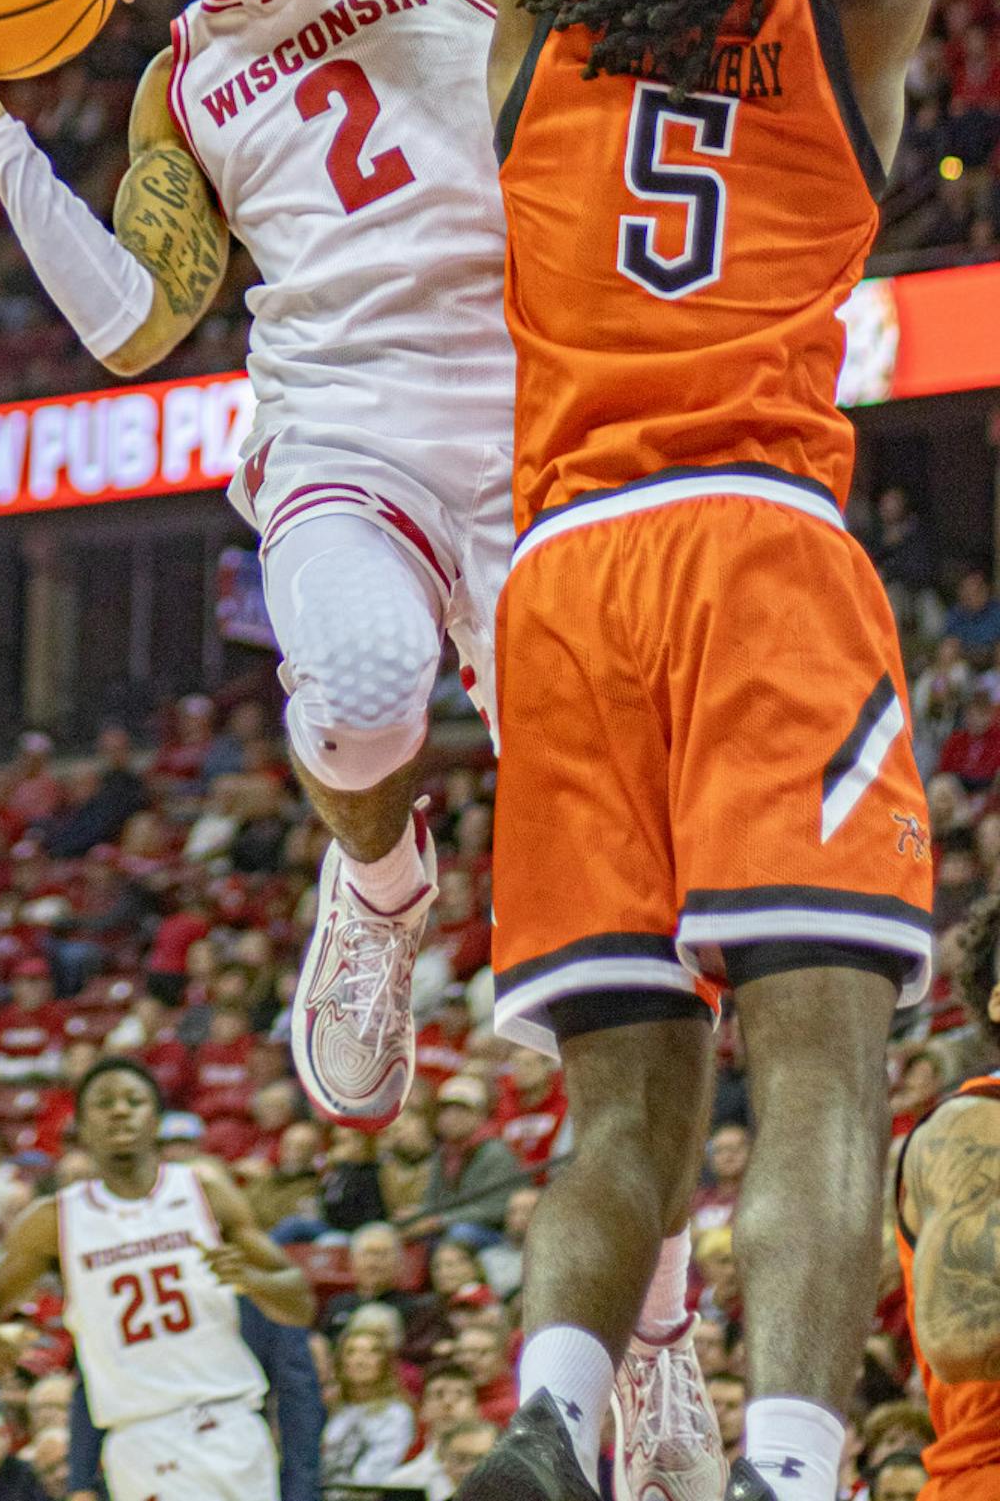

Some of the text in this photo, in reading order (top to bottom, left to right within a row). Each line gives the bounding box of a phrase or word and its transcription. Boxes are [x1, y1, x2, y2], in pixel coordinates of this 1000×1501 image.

[294, 58, 417, 216] 2
[616, 80, 741, 301] 5
[28, 391, 159, 501] PUB
[110, 1263, 193, 1346] 25
